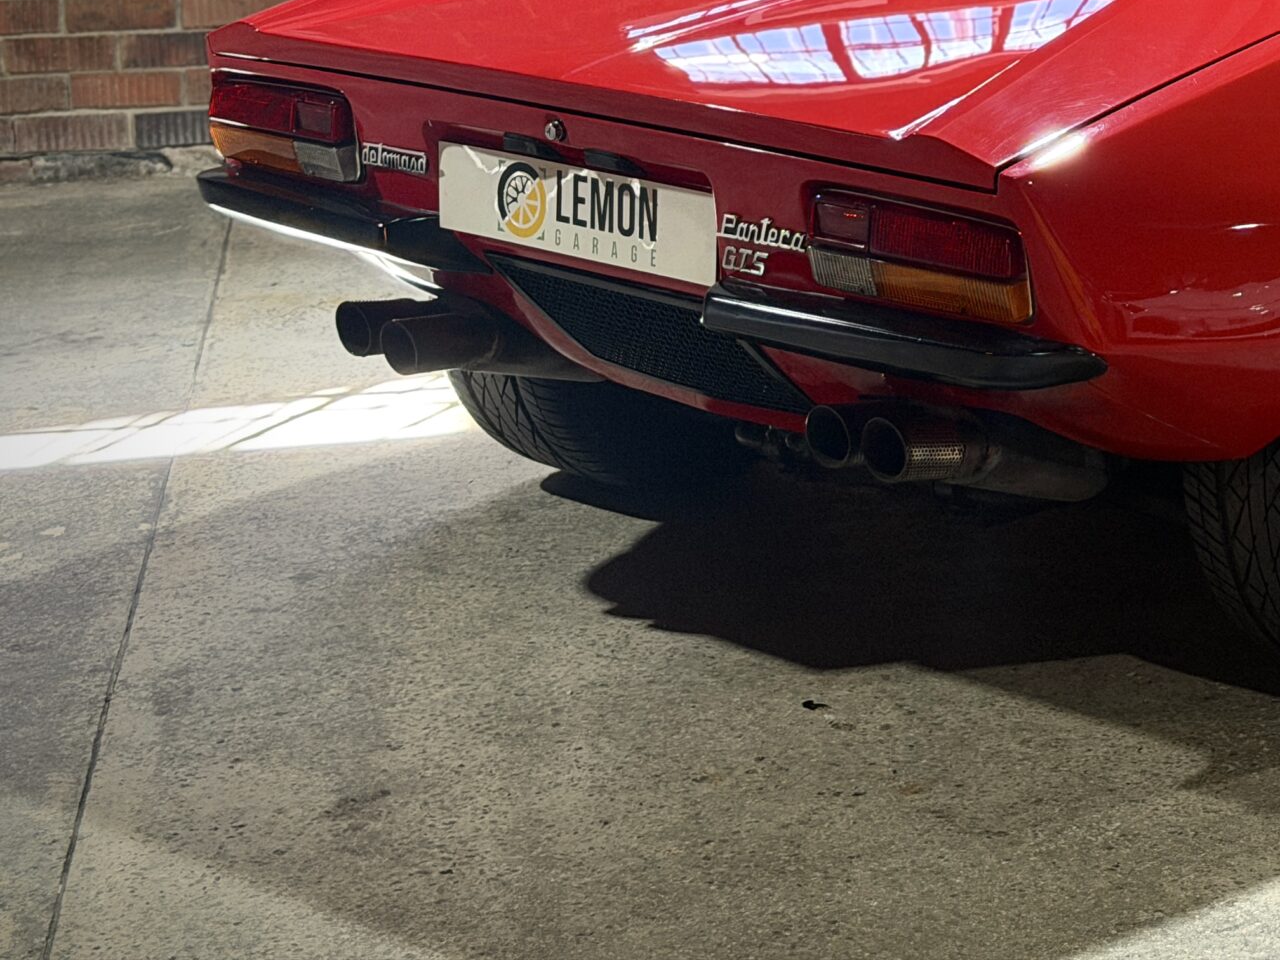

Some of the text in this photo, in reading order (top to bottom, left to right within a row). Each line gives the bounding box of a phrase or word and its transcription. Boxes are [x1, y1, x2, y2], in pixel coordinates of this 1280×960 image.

[556, 170, 658, 242] LEMON
[555, 228, 657, 268] GARAGE
[717, 213, 806, 253] Pantera
[722, 246, 769, 276] GTS
